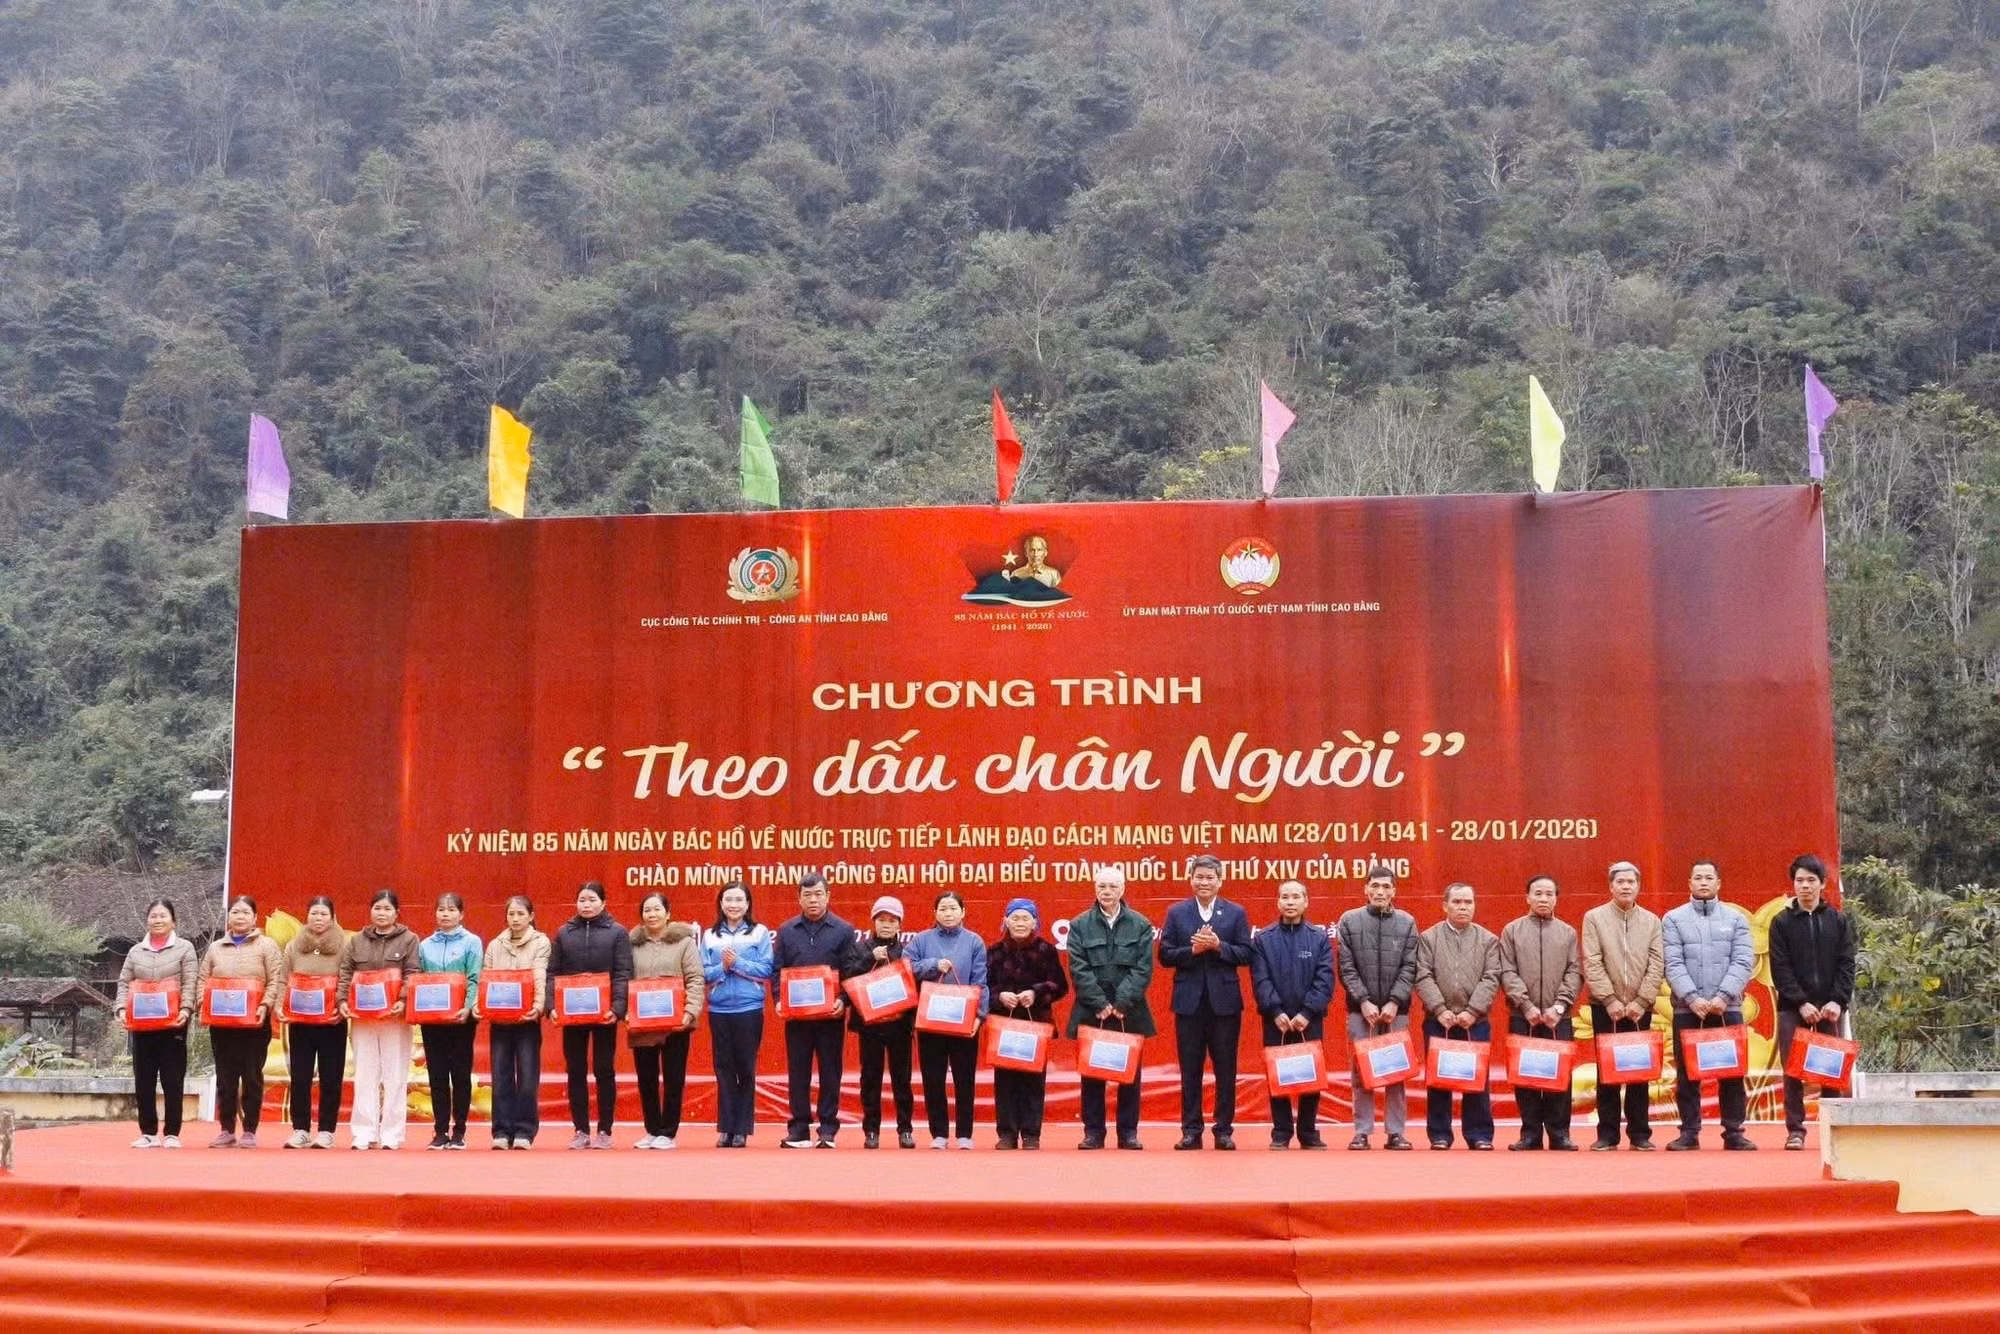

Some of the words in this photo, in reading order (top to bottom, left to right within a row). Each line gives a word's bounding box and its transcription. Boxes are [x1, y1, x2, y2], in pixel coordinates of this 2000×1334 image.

[641, 617, 660, 628] CỤC
[662, 615, 689, 627] CÔNG
[691, 615, 710, 626] TÁC
[712, 614, 742, 626] CHÍNH
[744, 615, 760, 626] TRỊ
[769, 612, 796, 624] CÔNG
[798, 614, 812, 624] AN
[814, 612, 837, 624] TỈNH
[839, 613, 859, 623] CAO
[861, 610, 888, 622] BẰNG
[1122, 604, 1137, 617] ỦY
[1138, 606, 1159, 617] BAN
[1160, 604, 1182, 619] MẶT
[1184, 603, 1210, 617] TRẬN
[1212, 601, 1225, 615] TỔ
[1227, 601, 1255, 616] QUỐC
[1257, 601, 1279, 615] VIỆT
[1280, 603, 1303, 613] NAM
[1305, 601, 1329, 613] TỈNH
[1330, 602, 1351, 612] CAO
[1353, 599, 1380, 612] BẰNG
[812, 679, 1036, 711] CHƯƠNG
[1050, 670, 1202, 706] TRÌNH
[622, 741, 789, 800] Theo
[811, 729, 957, 797] dấu
[974, 735, 1161, 794] chân
[1180, 730, 1405, 803] Người
[447, 827, 474, 853] KỶ
[478, 828, 527, 856] NIỆM
[532, 832, 558, 852] 85
[564, 828, 608, 852] NĂM
[614, 827, 667, 852] NGÀY
[672, 827, 712, 850] BÁC
[717, 824, 745, 850] HỒ
[749, 823, 776, 850] VỀ
[781, 824, 834, 850] NƯỚC
[839, 827, 892, 853] TRỰC
[897, 821, 941, 848] TIẾP
[946, 824, 1000, 848] LÃNH
[1005, 825, 1047, 850] ĐẠO
[1053, 822, 1107, 847] CÁCH
[1113, 824, 1174, 849] MẠNG
[1179, 819, 1225, 847] VIỆT
[1231, 823, 1278, 844] NAM
[1284, 822, 1428, 843] (28/01/1941
[1451, 818, 1598, 841] 28/01/2026)
[626, 862, 680, 887] CHÀO
[685, 863, 745, 887] MỪNG
[822, 860, 876, 886] CÔNG
[880, 863, 915, 887] ĐẠI
[920, 859, 954, 887] HỘI
[959, 862, 994, 886] ĐẠI
[1000, 854, 1046, 884] BIỂU
[1220, 856, 1260, 881] THỨ
[1264, 859, 1300, 880] XIV
[1305, 853, 1347, 880] CỦA
[1352, 852, 1410, 879] ĐẢNG
